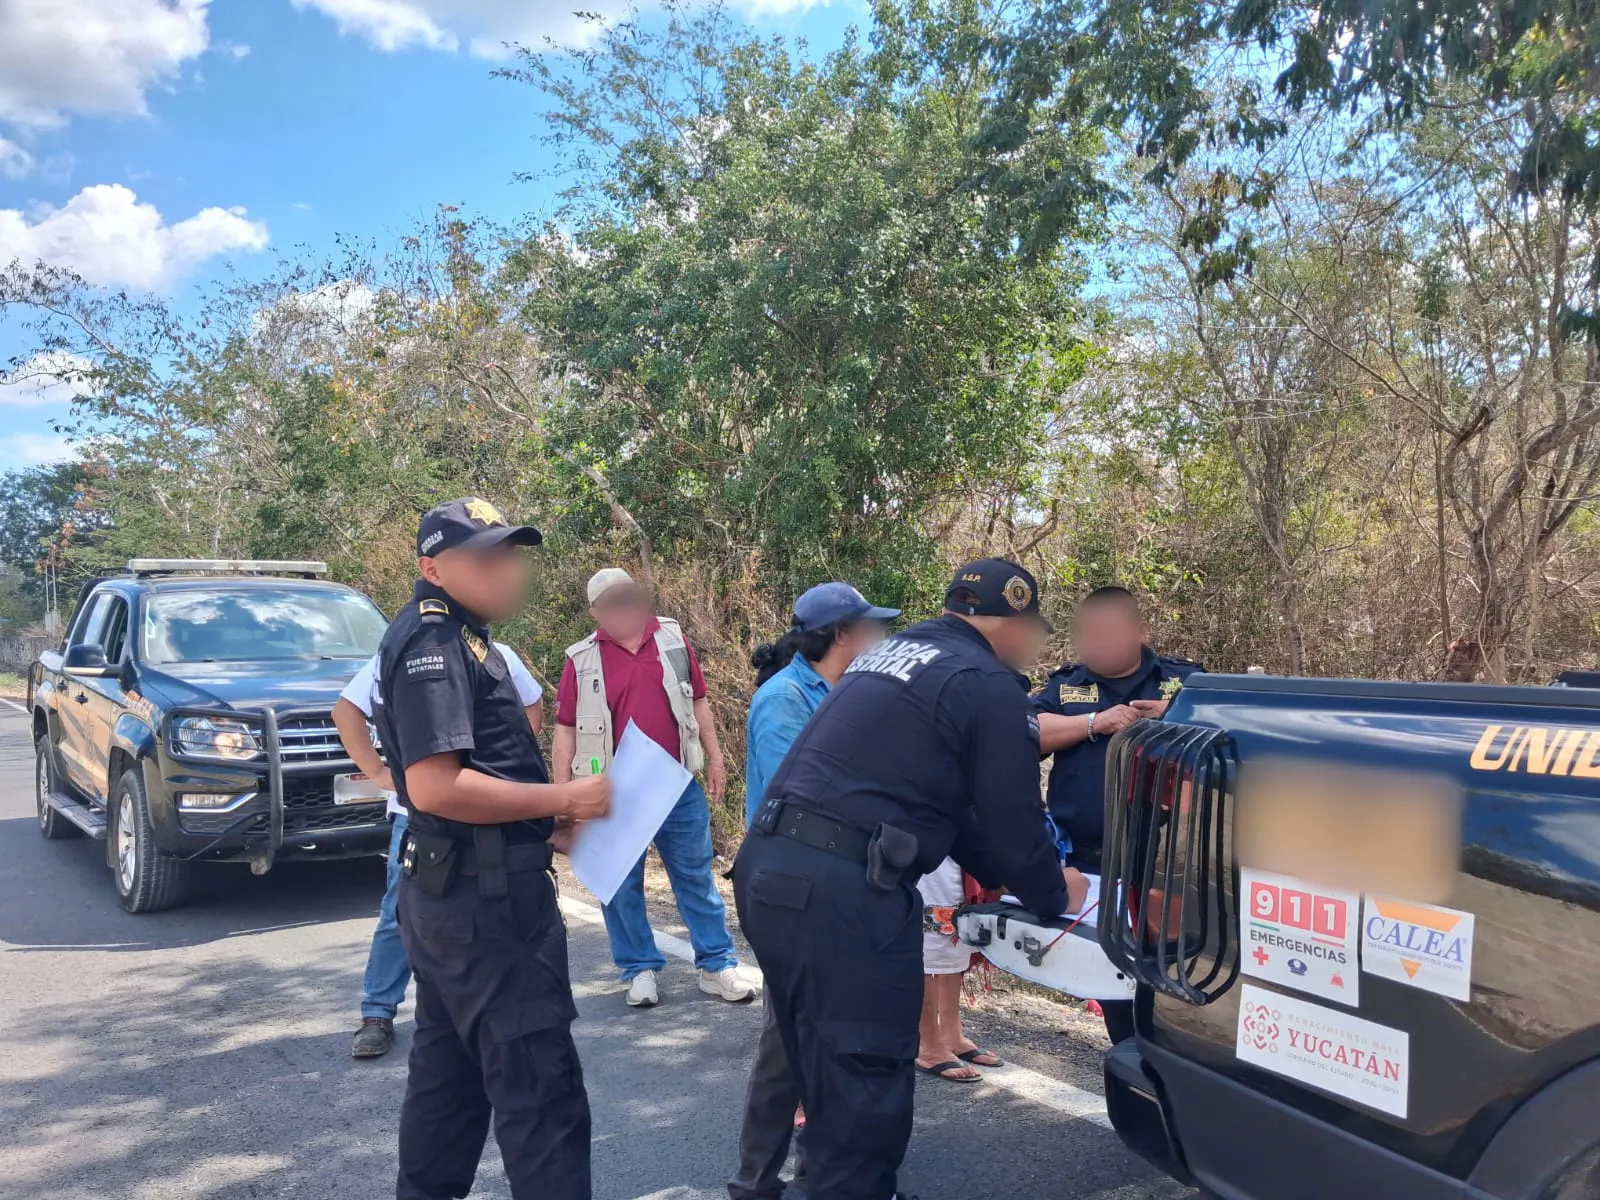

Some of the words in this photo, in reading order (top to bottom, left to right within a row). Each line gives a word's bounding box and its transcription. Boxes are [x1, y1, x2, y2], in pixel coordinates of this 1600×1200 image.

[406, 655, 444, 668] FUERZAS
[867, 639, 942, 665] OLICÍA
[1256, 889, 1335, 931] 911
[1250, 929, 1347, 964] EMERGENCIAS
[1366, 916, 1464, 963] CALEA
[1287, 1027, 1400, 1081] YUCATÁN
